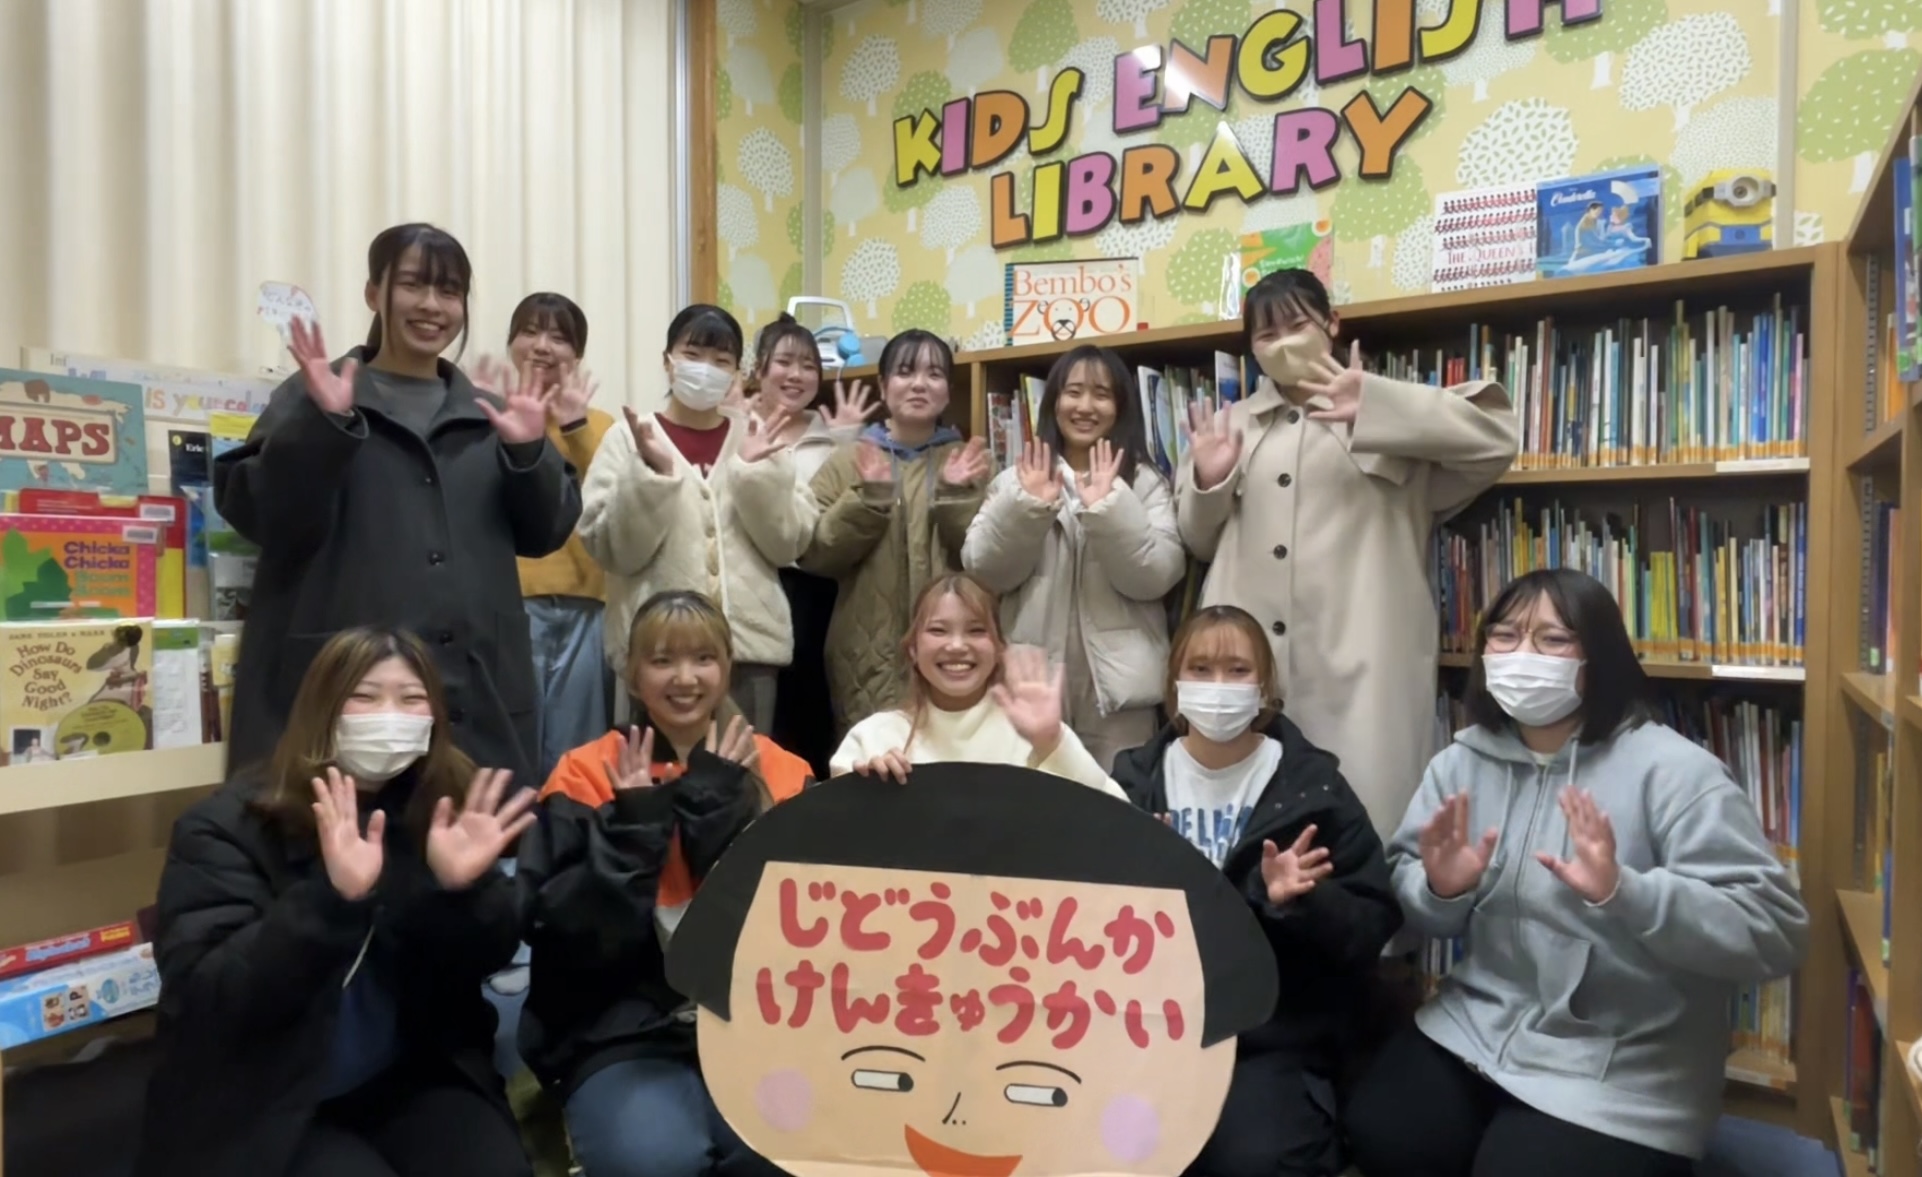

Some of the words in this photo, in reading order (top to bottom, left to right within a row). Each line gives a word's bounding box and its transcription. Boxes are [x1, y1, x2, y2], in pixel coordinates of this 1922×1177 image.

[894, 67, 1085, 188] KIDS
[990, 86, 1434, 250] LIBRARY
[1012, 263, 1132, 296] Bembo's
[1008, 296, 1131, 340] ZOO
[64, 541, 130, 555] Chicka
[64, 556, 130, 570] Chicka
[16, 643, 51, 659] How
[55, 641, 76, 656] Do
[9, 654, 83, 677] Dinosaurs
[33, 668, 59, 682] Say
[24, 678, 67, 695] Good
[779, 877, 1175, 975] じどうぶんか
[755, 959, 1185, 1050] けんきゅうかい
